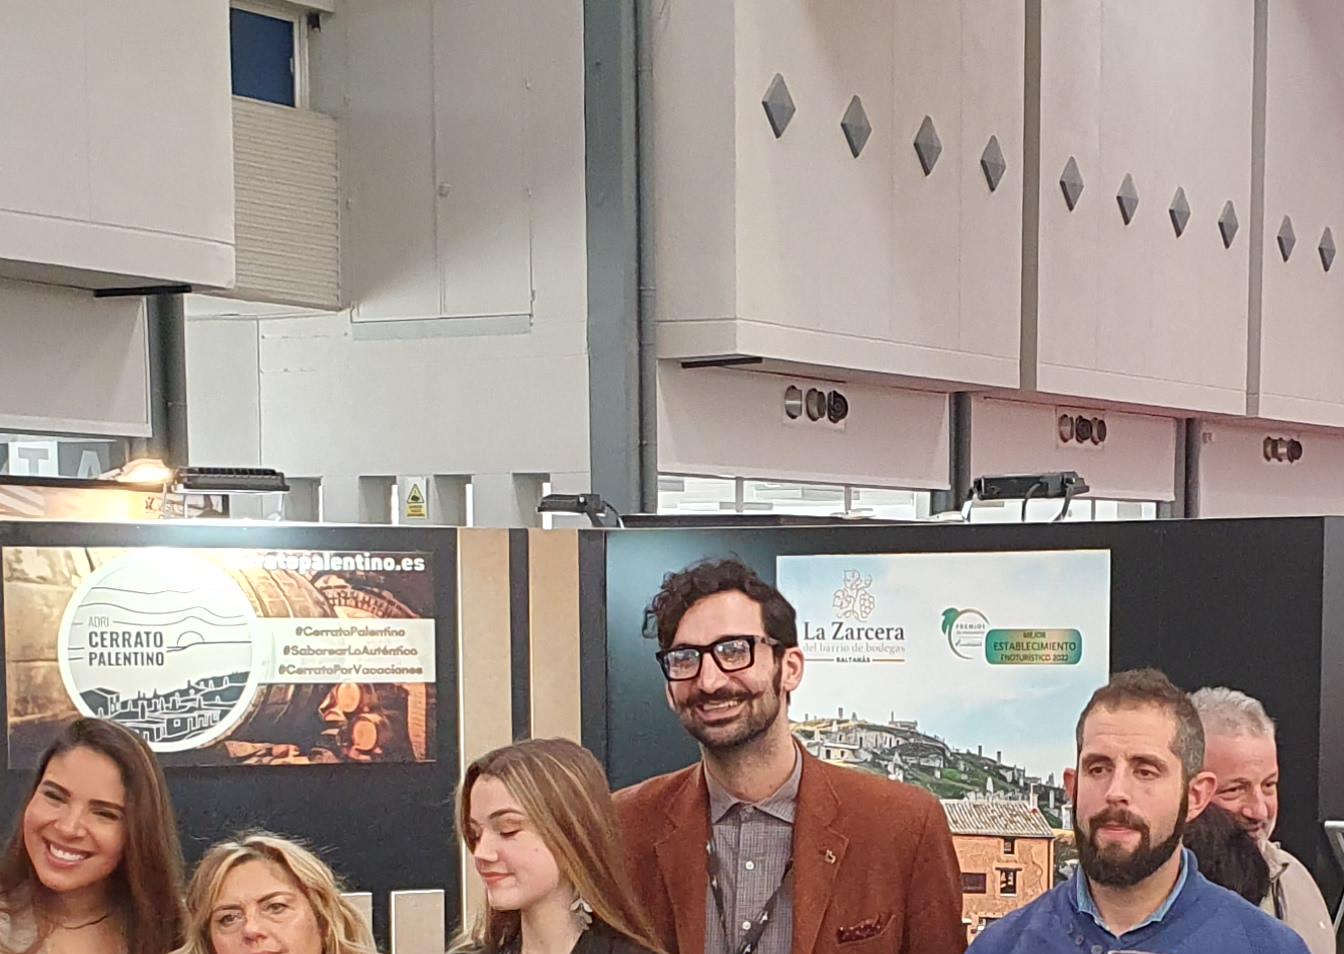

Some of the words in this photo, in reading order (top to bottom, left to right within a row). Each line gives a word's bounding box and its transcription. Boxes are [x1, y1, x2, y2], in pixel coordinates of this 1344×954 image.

[88, 616, 109, 628] ADRI
[295, 625, 406, 637] #CerratoPalentino
[804, 622, 825, 641] La
[832, 621, 905, 641] Zarcera
[88, 631, 163, 648] CERRATO
[993, 641, 1076, 651] ESTABLECIMIENTO
[88, 652, 164, 666] PALENTINO
